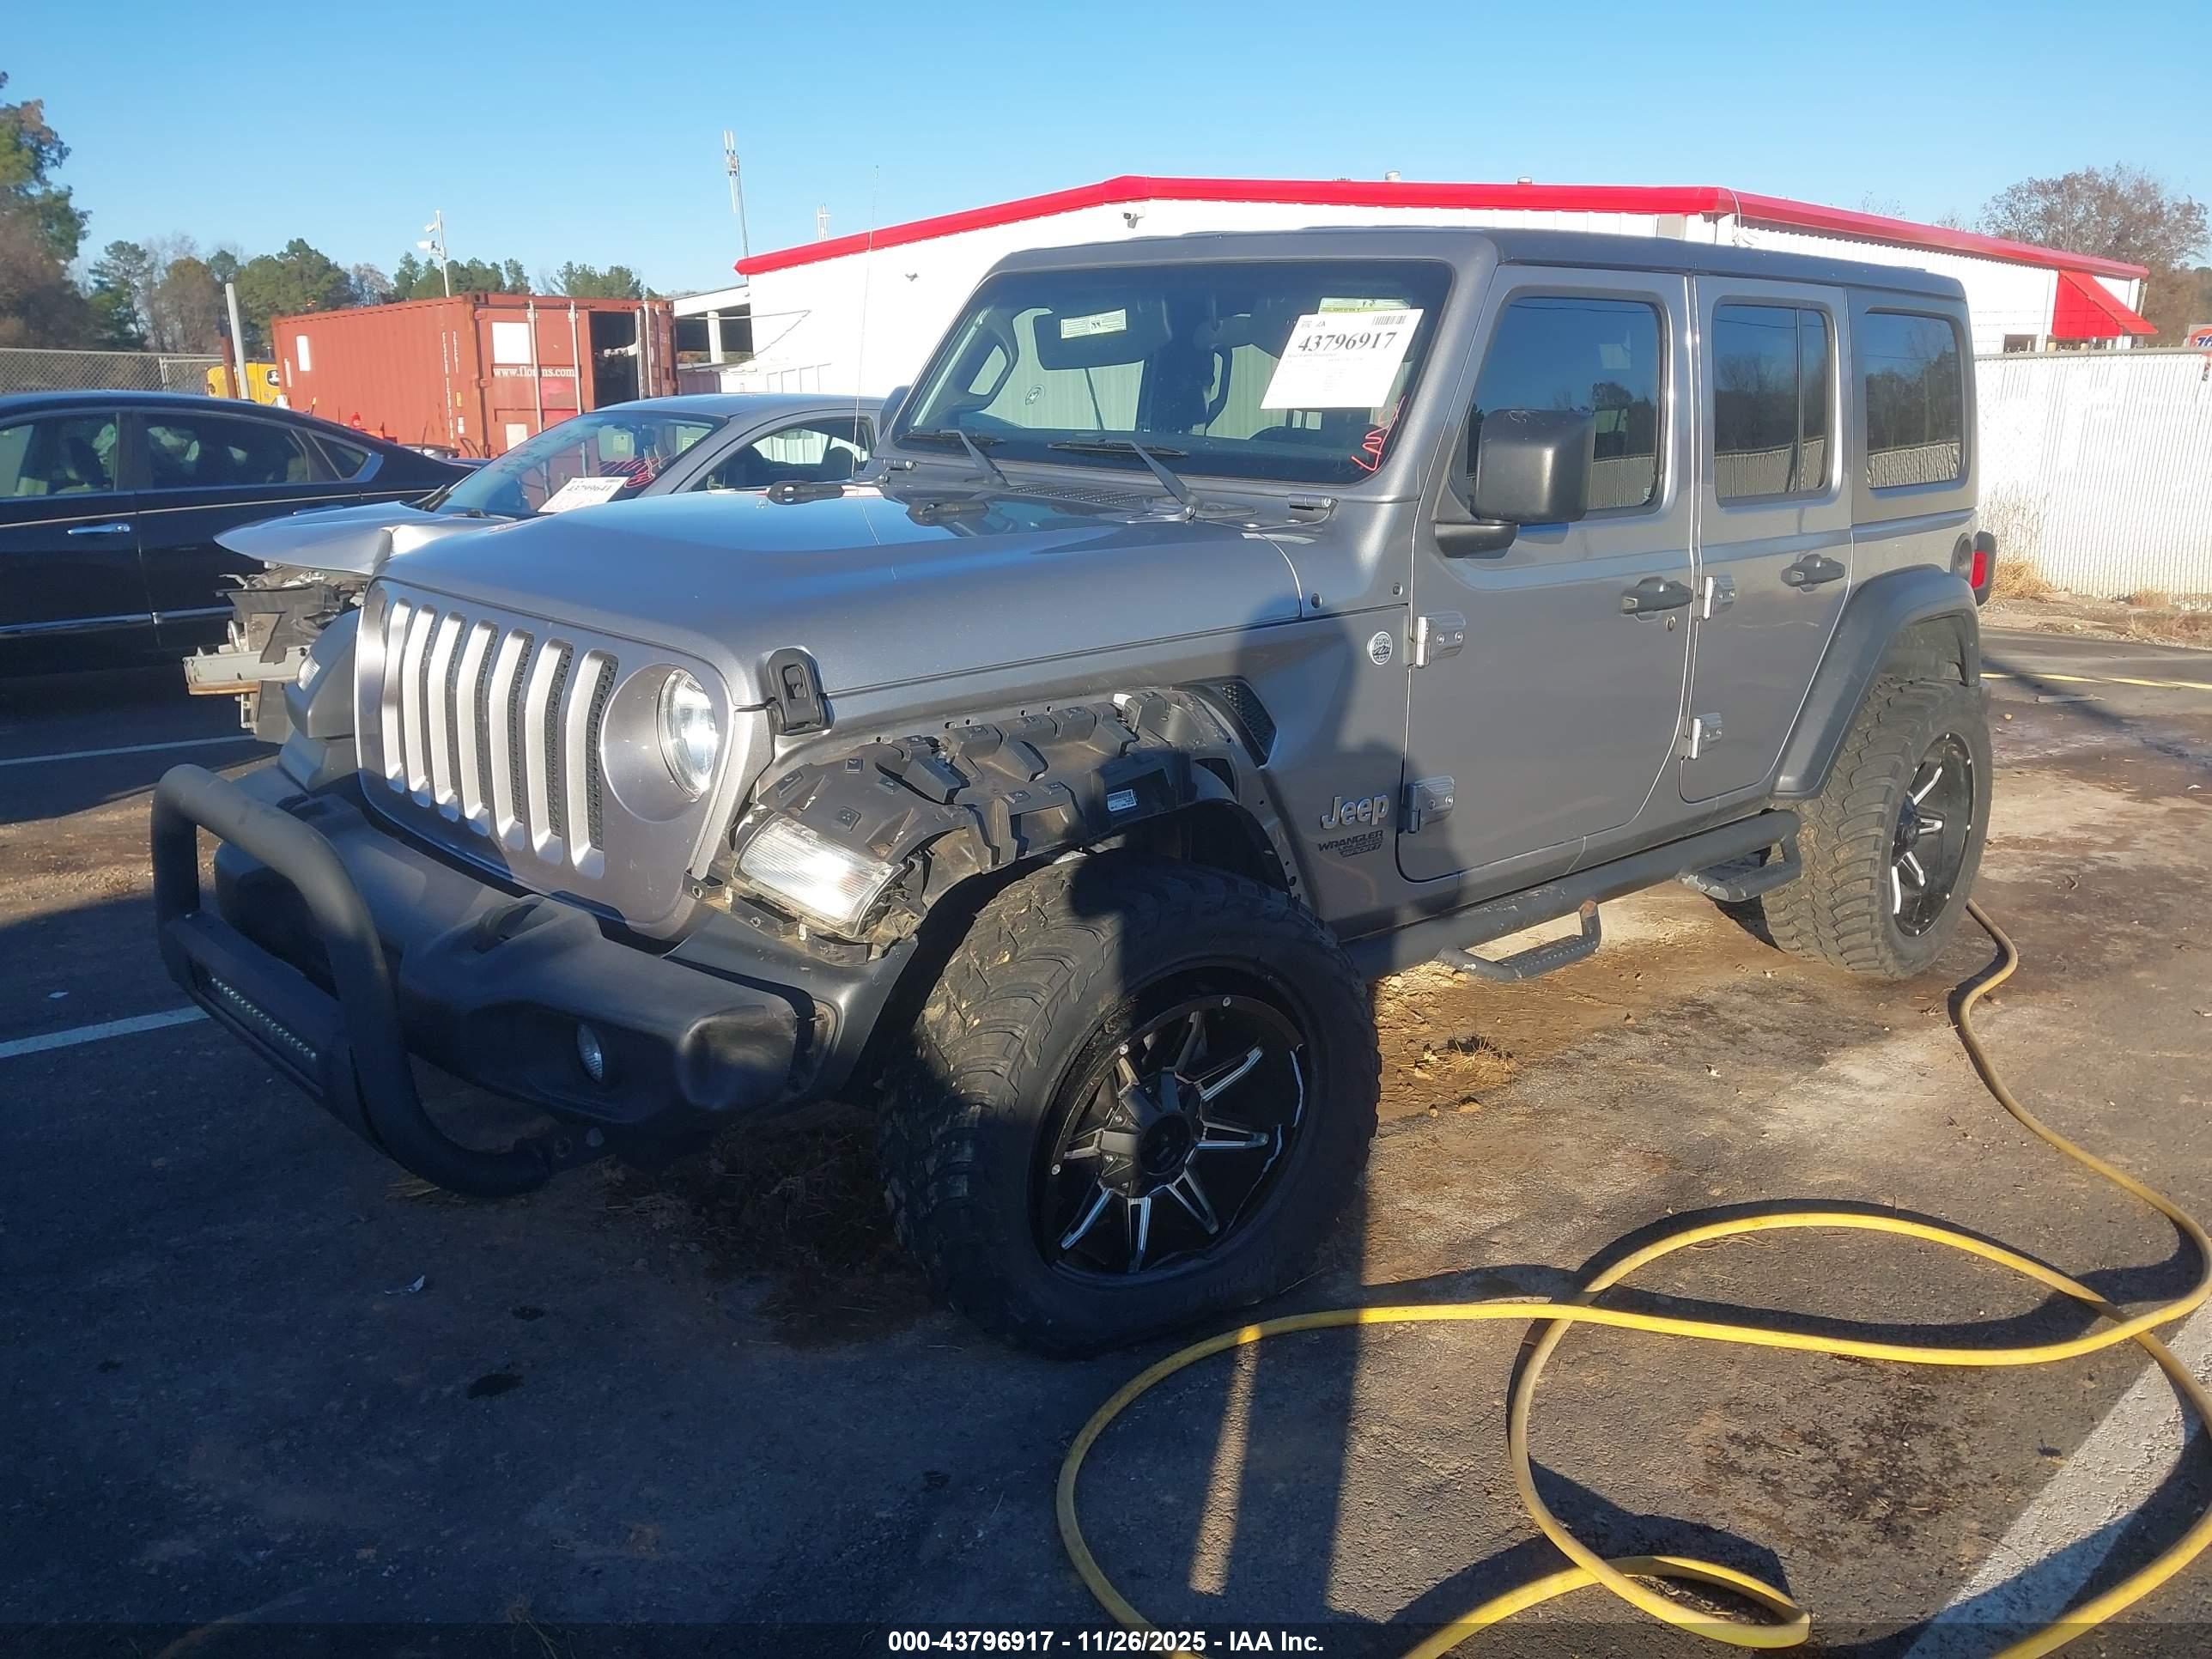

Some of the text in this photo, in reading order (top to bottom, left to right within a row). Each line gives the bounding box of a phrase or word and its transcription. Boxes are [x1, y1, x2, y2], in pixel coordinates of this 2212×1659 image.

[1298, 331, 1397, 351] 43796917
[1320, 794, 1389, 830] Jeep
[1317, 830, 1383, 852] WRANGLER
